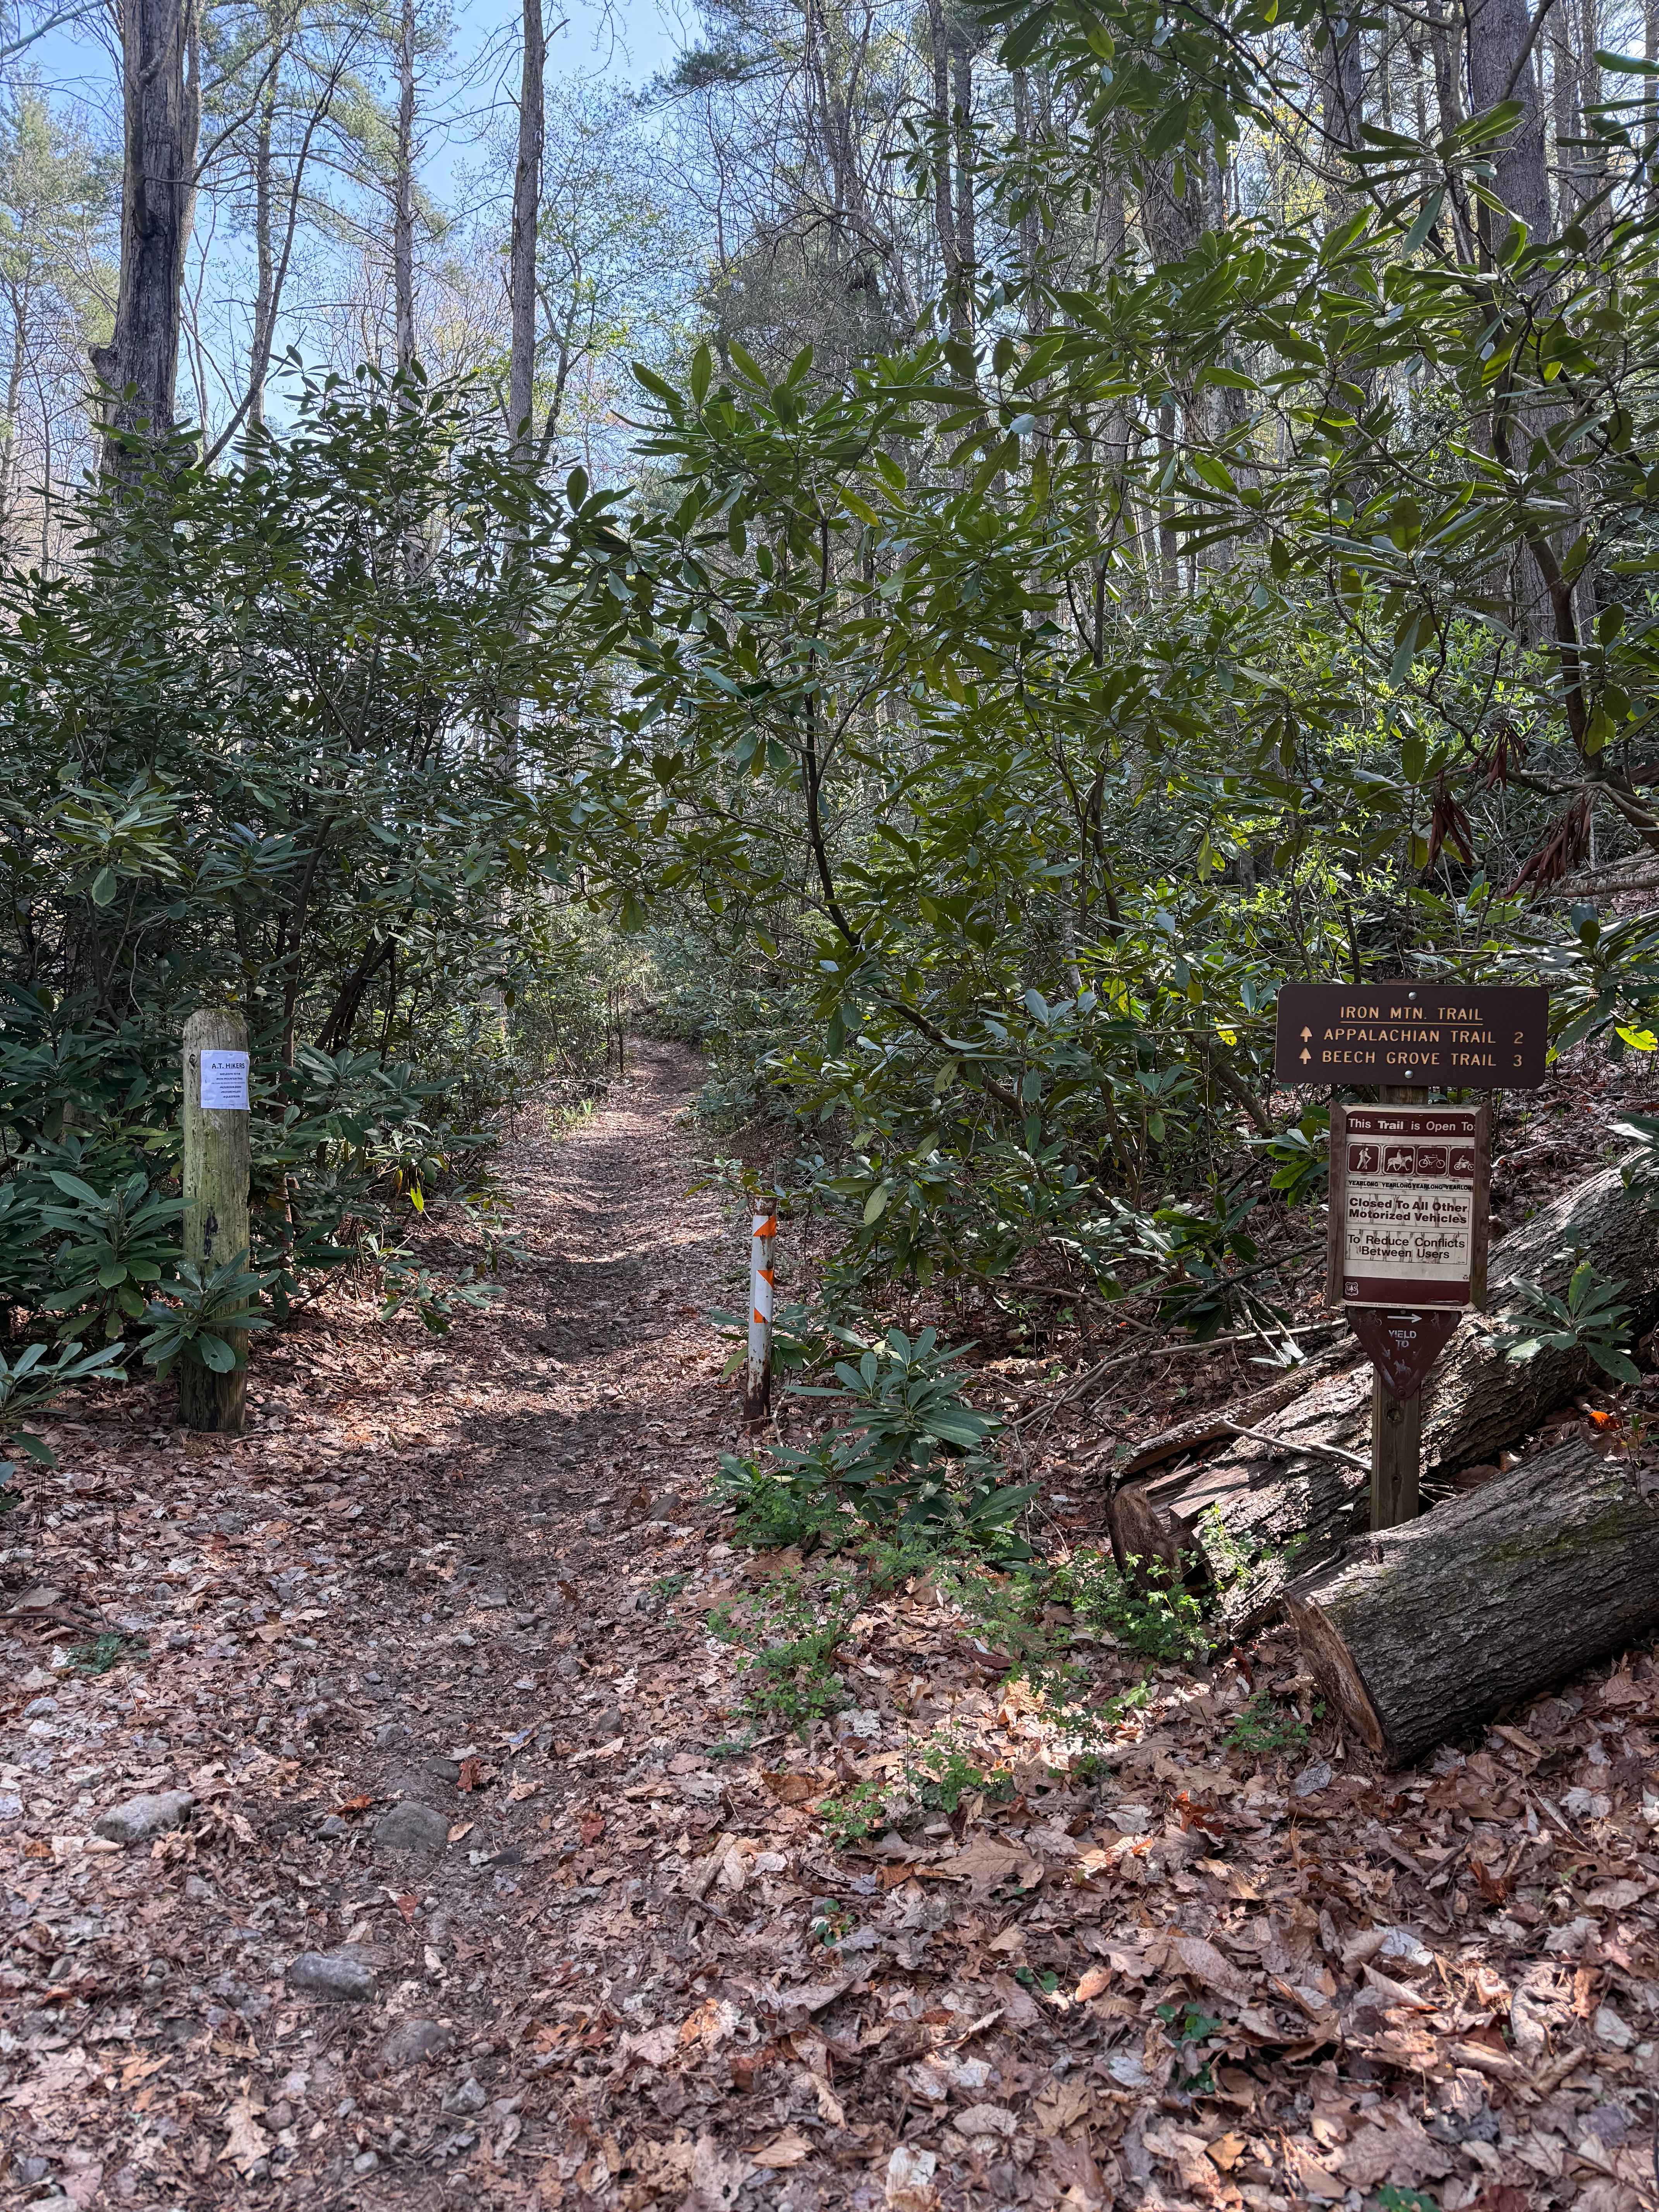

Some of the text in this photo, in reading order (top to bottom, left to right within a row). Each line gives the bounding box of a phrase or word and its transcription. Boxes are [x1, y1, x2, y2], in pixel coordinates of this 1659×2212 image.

[1340, 1006, 1483, 1020] IRON MTN. TRAIL
[1324, 1028, 1524, 1044] APPALACHIAN TRAIL 2
[1322, 1050, 1522, 1067] BEECH GROVE TRAIL 3
[1348, 1118, 1371, 1128] This
[1377, 1120, 1404, 1130] Trail
[1411, 1121, 1420, 1130] is
[1426, 1121, 1456, 1132] Open
[1349, 1197, 1467, 1212] Closed To All Other
[1349, 1209, 1467, 1224] Motorized Vehicles
[1347, 1234, 1465, 1248] To Reduce Conflicts
[1361, 1246, 1450, 1259] Between Users
[1388, 1329, 1417, 1339] YIELD
[1395, 1340, 1409, 1348] TO
